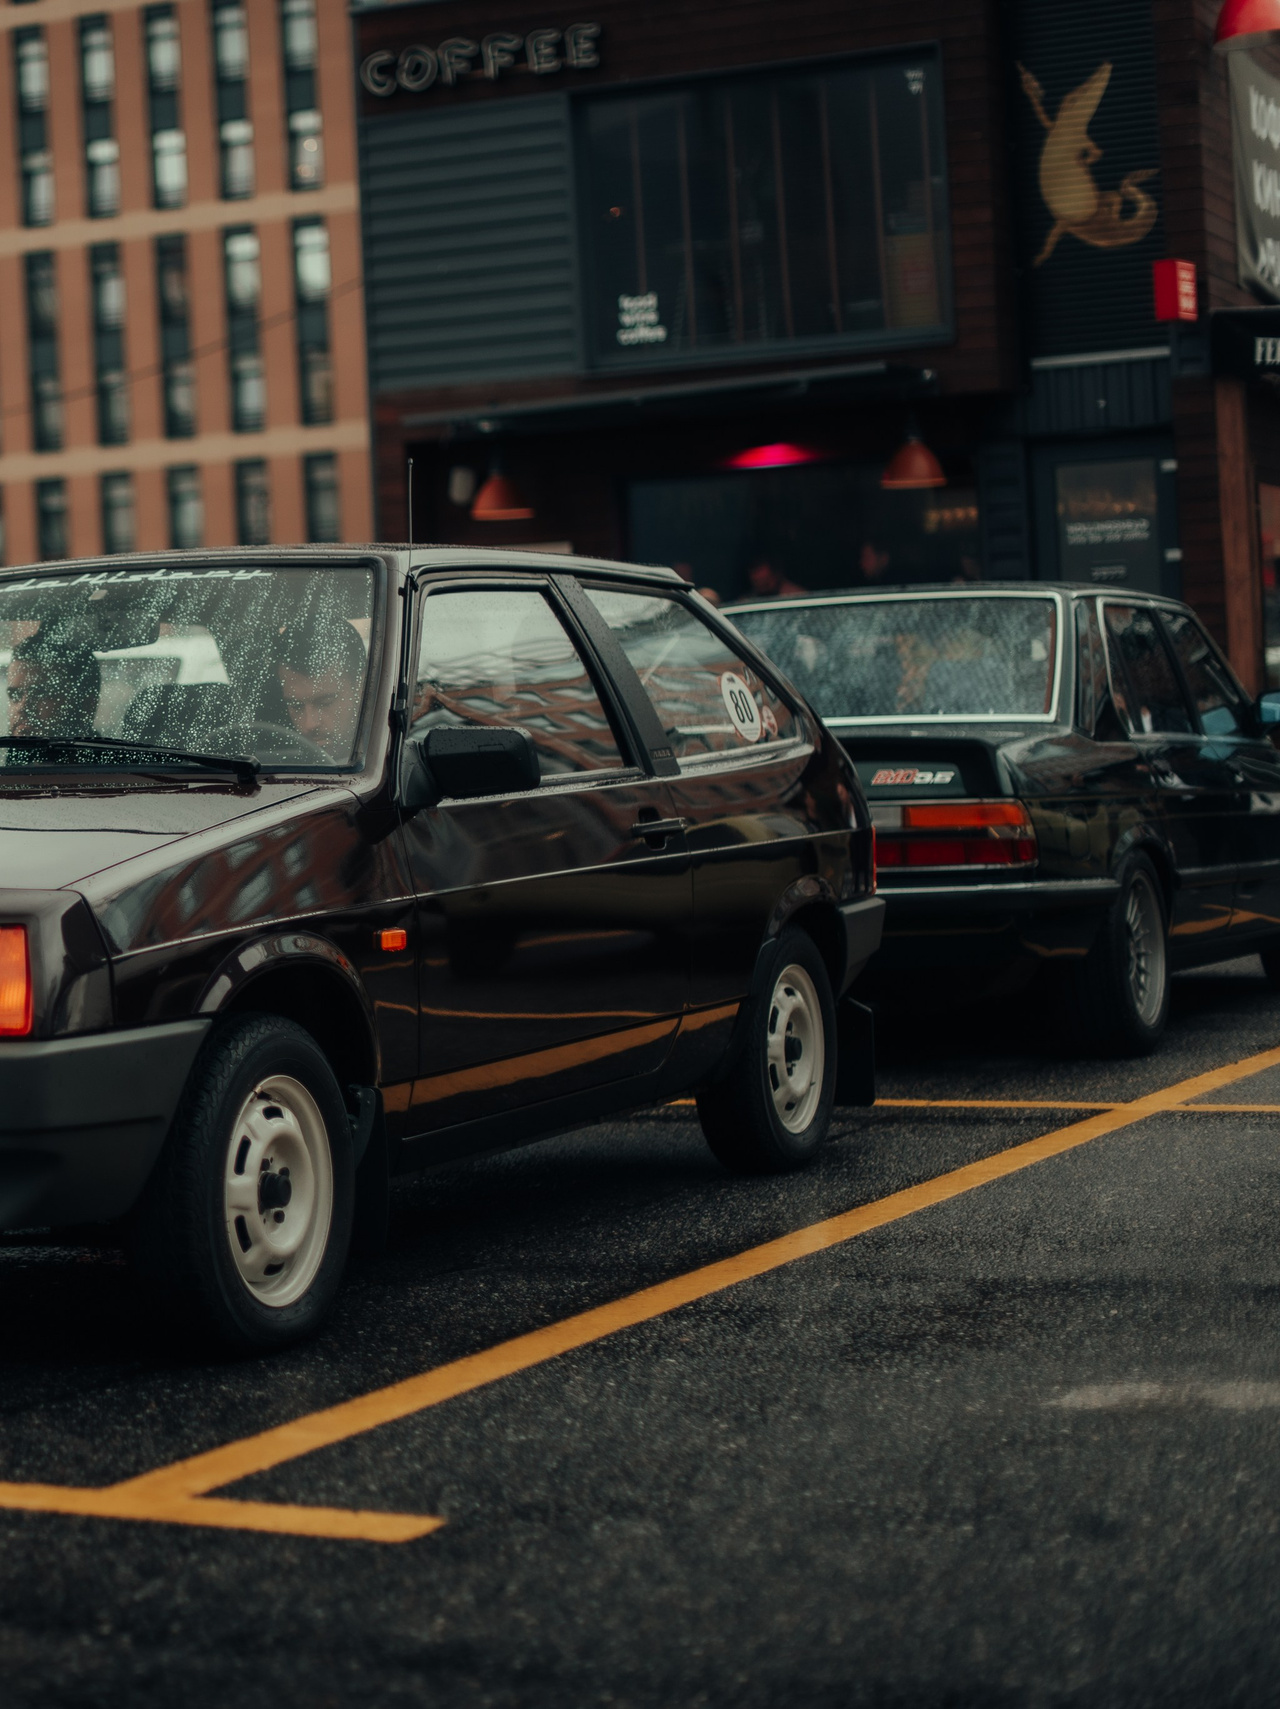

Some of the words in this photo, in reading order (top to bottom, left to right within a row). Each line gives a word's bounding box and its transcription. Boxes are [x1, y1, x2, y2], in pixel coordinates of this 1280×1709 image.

[360, 22, 602, 97] COFFEE
[70, 568, 273, 586] History
[729, 690, 754, 723] 80
